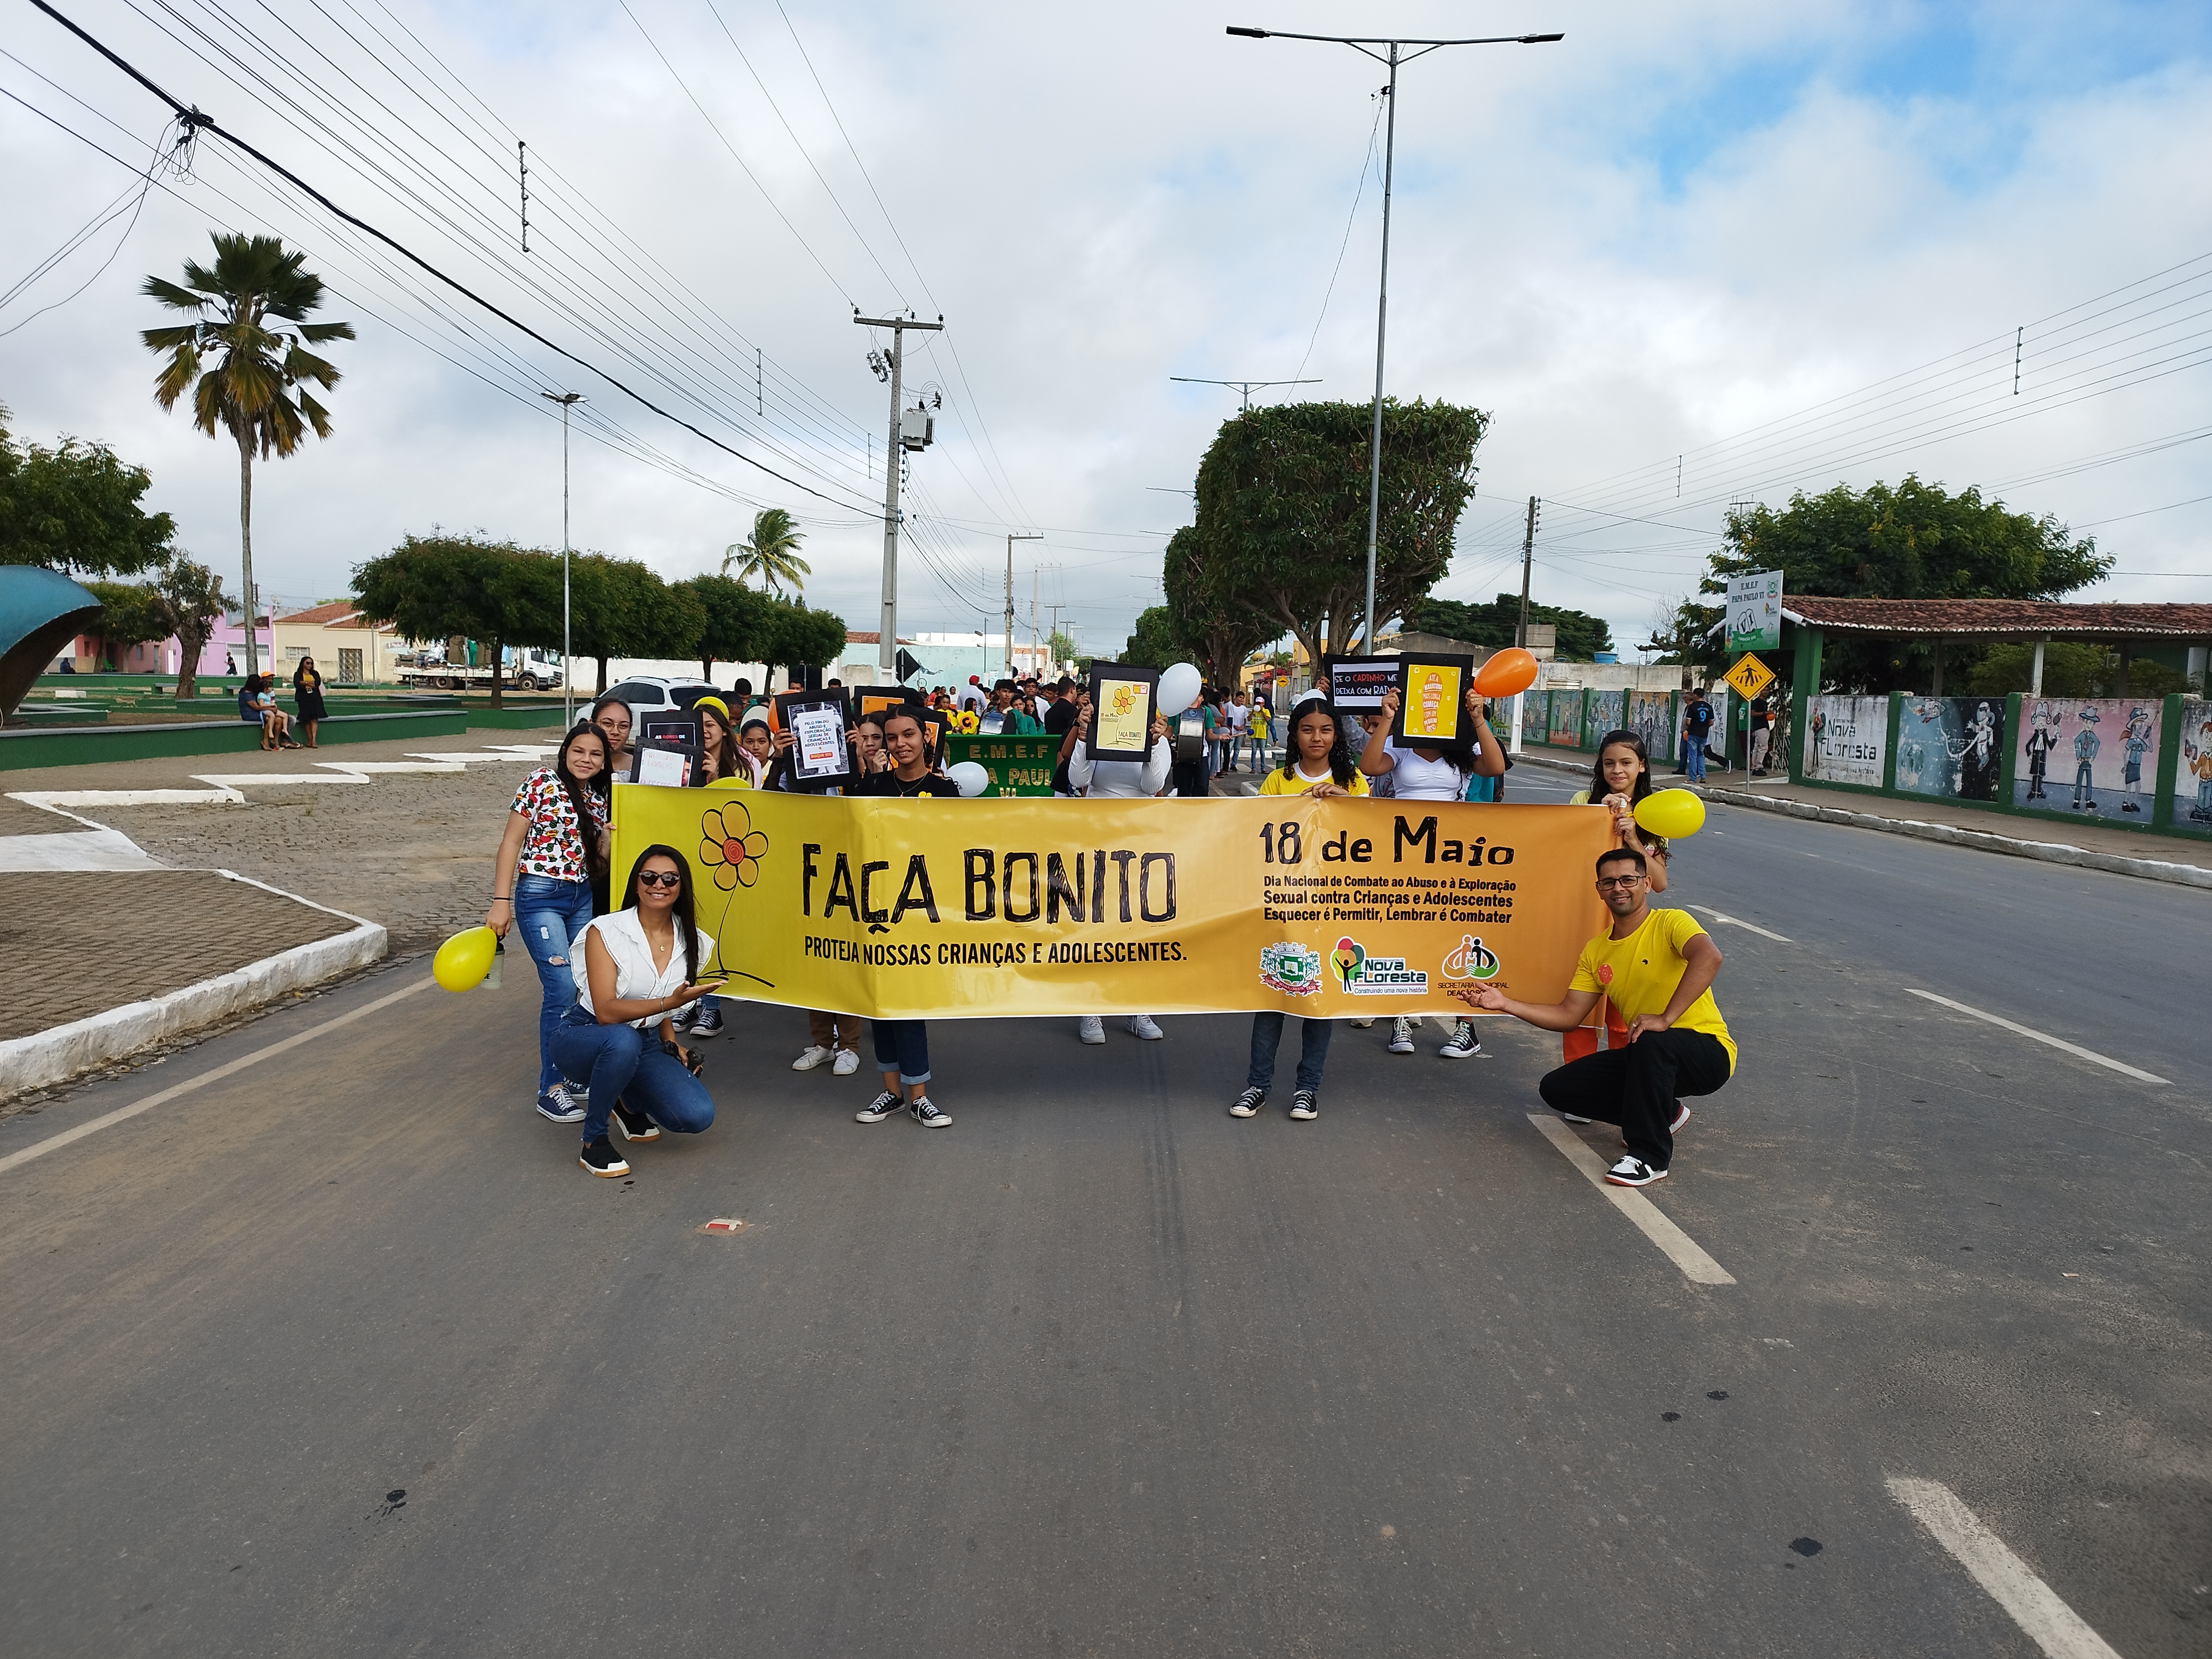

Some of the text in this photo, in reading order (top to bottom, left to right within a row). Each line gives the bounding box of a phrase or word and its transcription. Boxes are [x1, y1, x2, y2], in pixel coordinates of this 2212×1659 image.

[1732, 594, 1743, 603] PAPA
[1744, 592, 1759, 601] PAULO
[1353, 674, 1385, 682] CARINHO
[1700, 711, 1706, 722] 9
[1828, 718, 1855, 737] Nova
[969, 744, 1048, 758] E.M.E.F
[1259, 815, 1514, 867] 18 de Maio
[803, 843, 1176, 935] FAÇA BONITO
[1264, 875, 1516, 893] Dia Nacional de Combate ao Abuso e à Exploração
[1264, 890, 1513, 907] Sexual contra Crianças e Adolescentes
[1264, 906, 1512, 924] Esquecer é Permitir, Lembrar é Combater
[805, 936, 1187, 968] PROTEJA NOSSAS CRIANÇAS E ADOLESCENTES.
[1365, 959, 1404, 971] Nova
